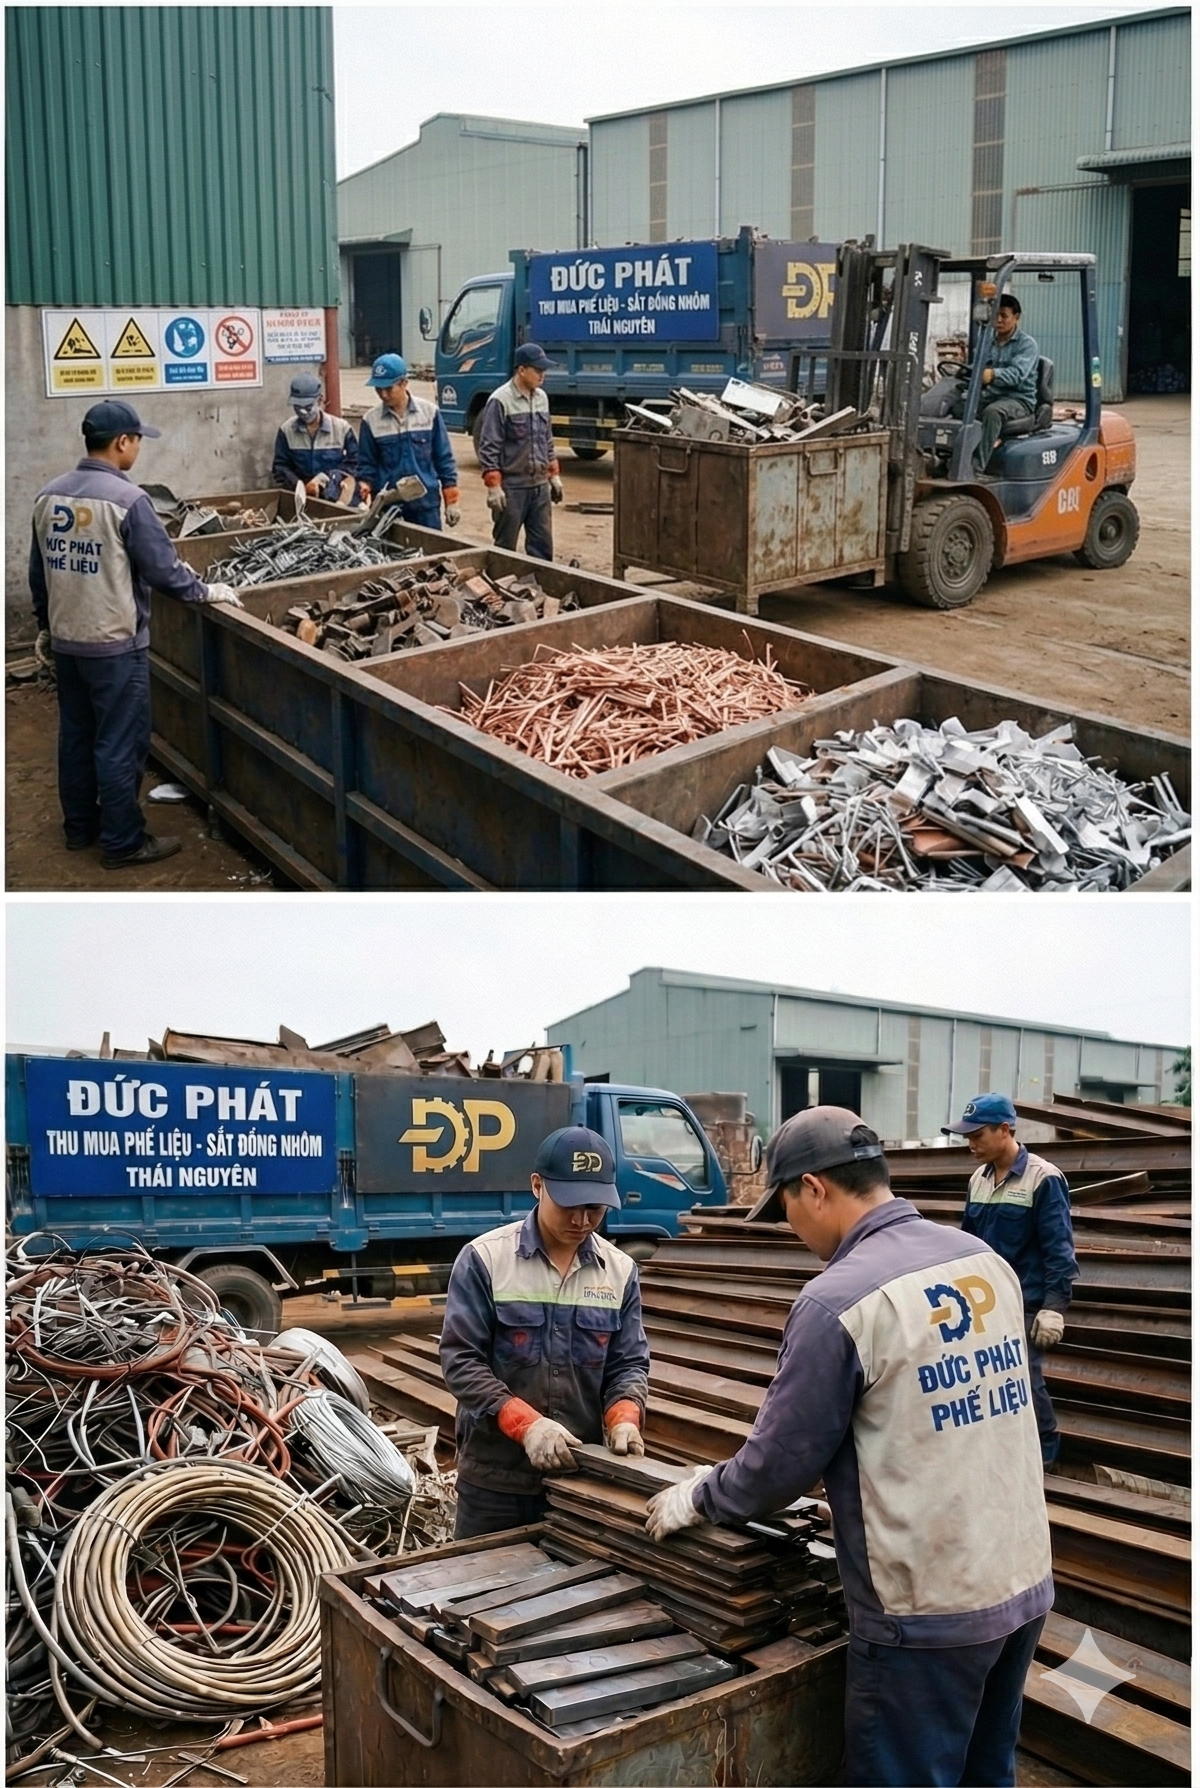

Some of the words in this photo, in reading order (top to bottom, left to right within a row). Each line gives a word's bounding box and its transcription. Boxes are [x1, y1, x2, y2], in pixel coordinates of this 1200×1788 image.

[550, 258, 606, 292] ĐỨC
[614, 253, 692, 289] PHÁT
[66, 1074, 169, 1118] ĐỨC
[185, 1081, 302, 1122] PHÁT
[46, 1130, 79, 1155] THU
[83, 1130, 120, 1156] MUA
[124, 1124, 155, 1156] PHẾ
[159, 1127, 192, 1161] LIỆU
[280, 1130, 322, 1157] NHÔM
[126, 1162, 173, 1187] THÁI
[179, 1163, 257, 1187] NGUYÊN
[917, 1353, 971, 1393] ĐỨC
[974, 1335, 1023, 1378] PHÁT
[931, 1385, 984, 1432] PHẾ
[989, 1377, 1029, 1418] LIỆU
